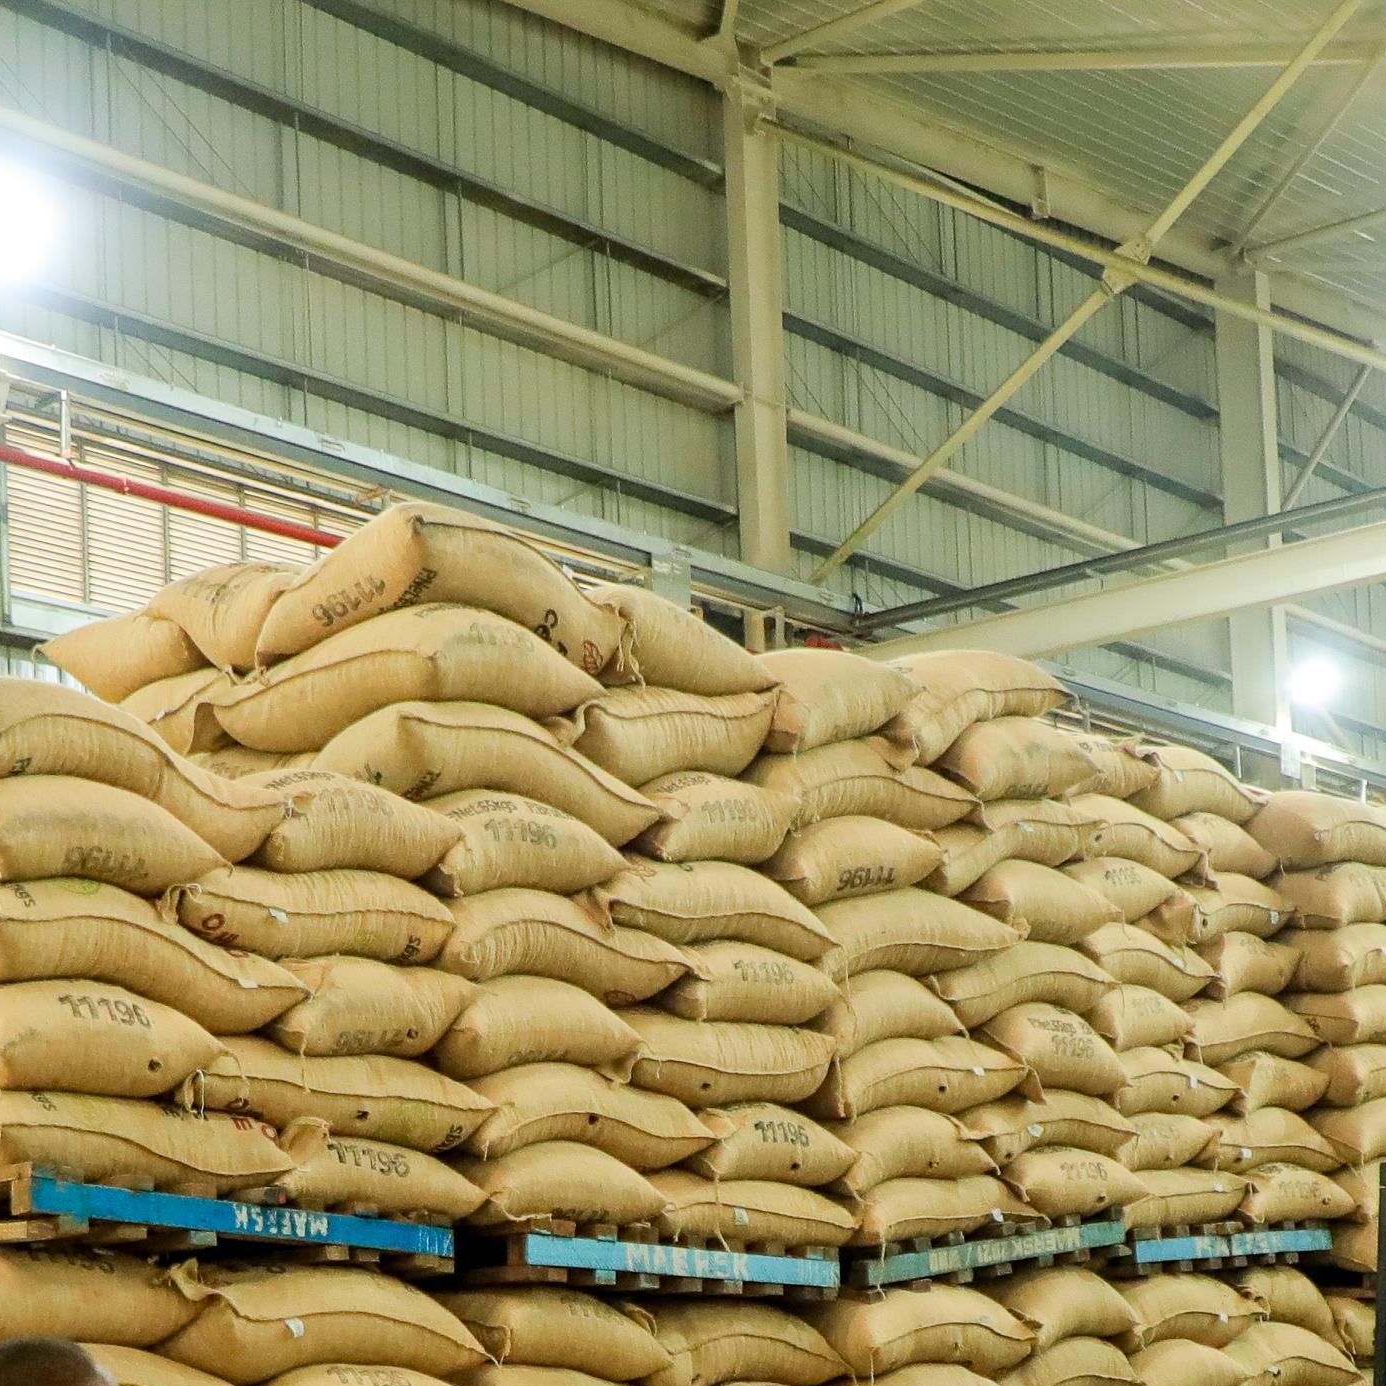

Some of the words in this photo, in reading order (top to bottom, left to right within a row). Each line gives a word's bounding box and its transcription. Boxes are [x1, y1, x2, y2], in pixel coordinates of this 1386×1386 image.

[485, 818, 558, 849] 11196
[836, 864, 896, 892] 11196
[59, 993, 153, 1029] 11196
